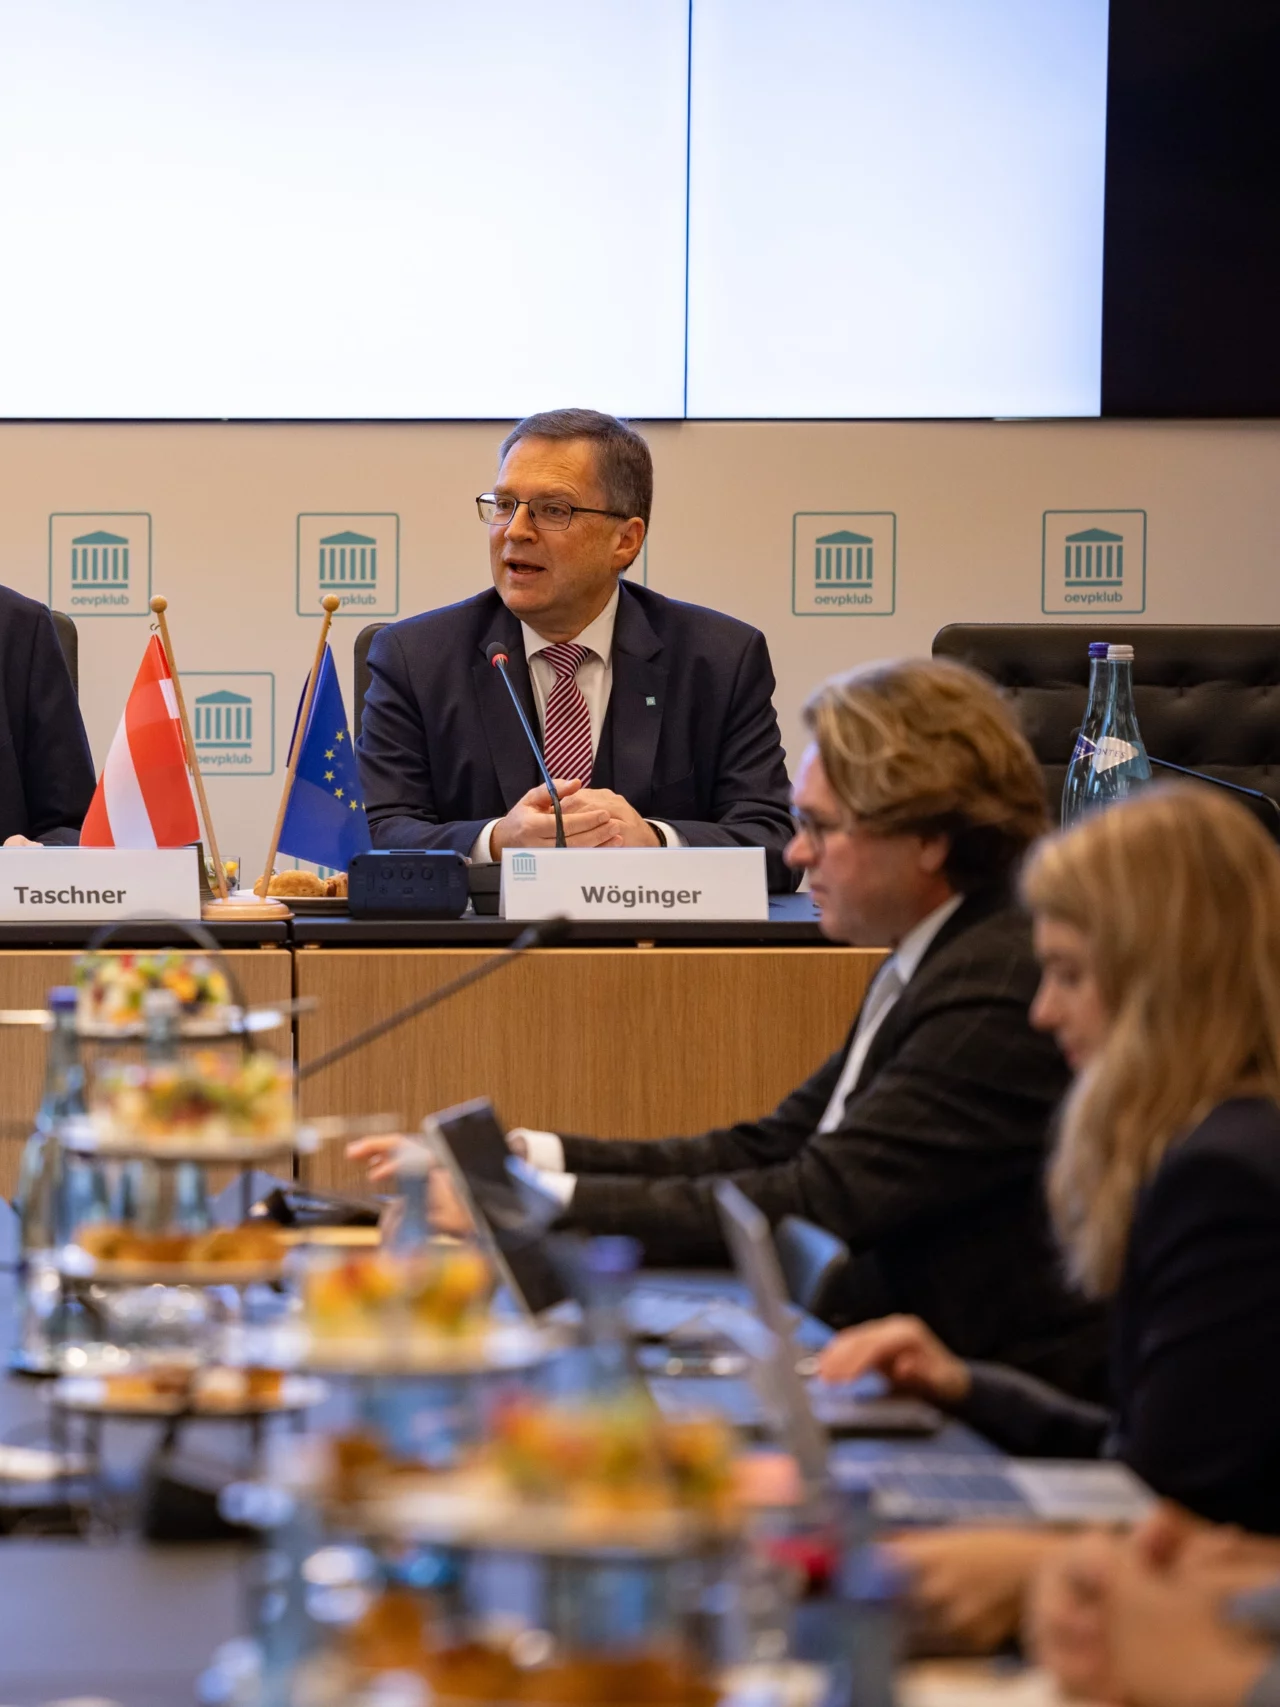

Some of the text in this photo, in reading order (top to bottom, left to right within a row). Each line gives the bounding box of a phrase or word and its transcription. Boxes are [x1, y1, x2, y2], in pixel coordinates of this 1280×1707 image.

[71, 593, 129, 607] oevpklub
[814, 593, 873, 607] oevpklub
[1064, 591, 1123, 605] oevpklub
[13, 885, 127, 904] Taschner
[580, 885, 702, 908] Wöginger
